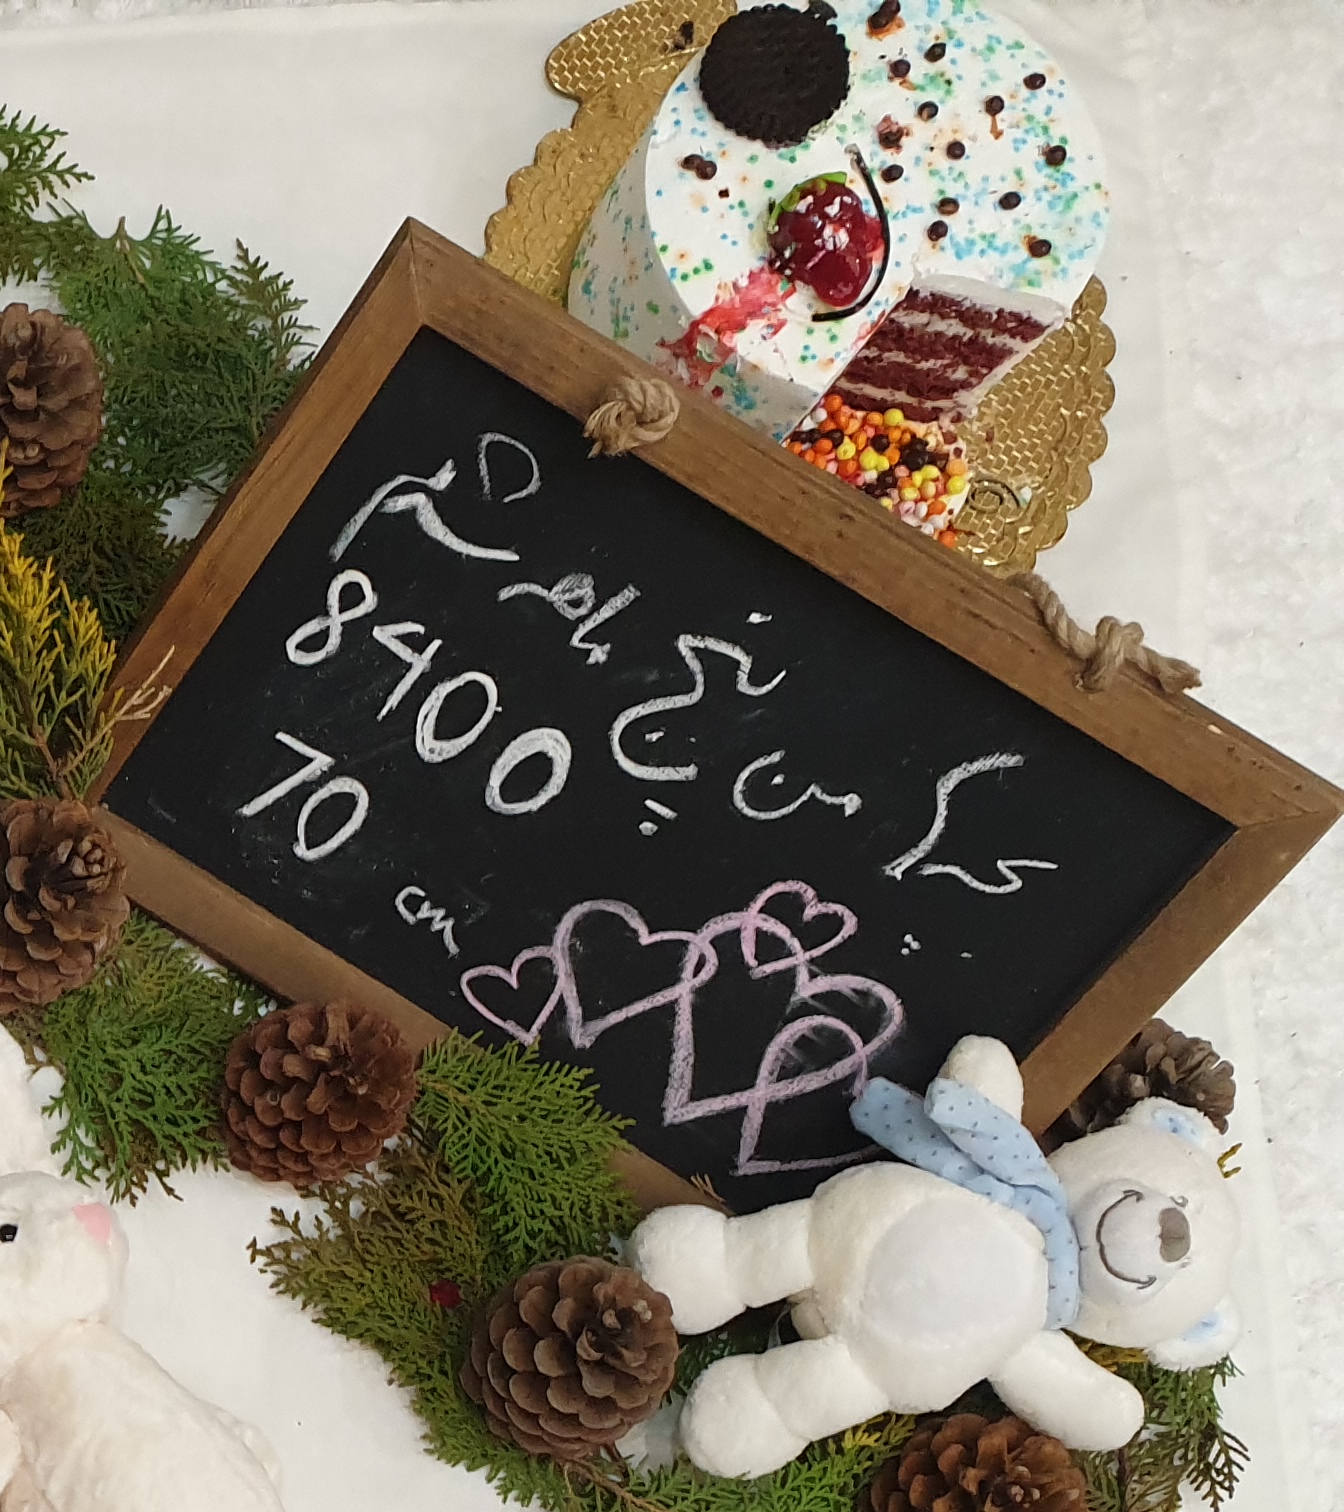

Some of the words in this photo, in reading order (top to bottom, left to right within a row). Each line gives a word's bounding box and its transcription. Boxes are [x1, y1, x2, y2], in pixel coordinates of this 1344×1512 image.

[284, 567, 573, 815] 8400
[609, 610, 788, 837] پنج
[733, 748, 863, 821] من
[237, 730, 370, 862] 70
[394, 885, 460, 959] cm
